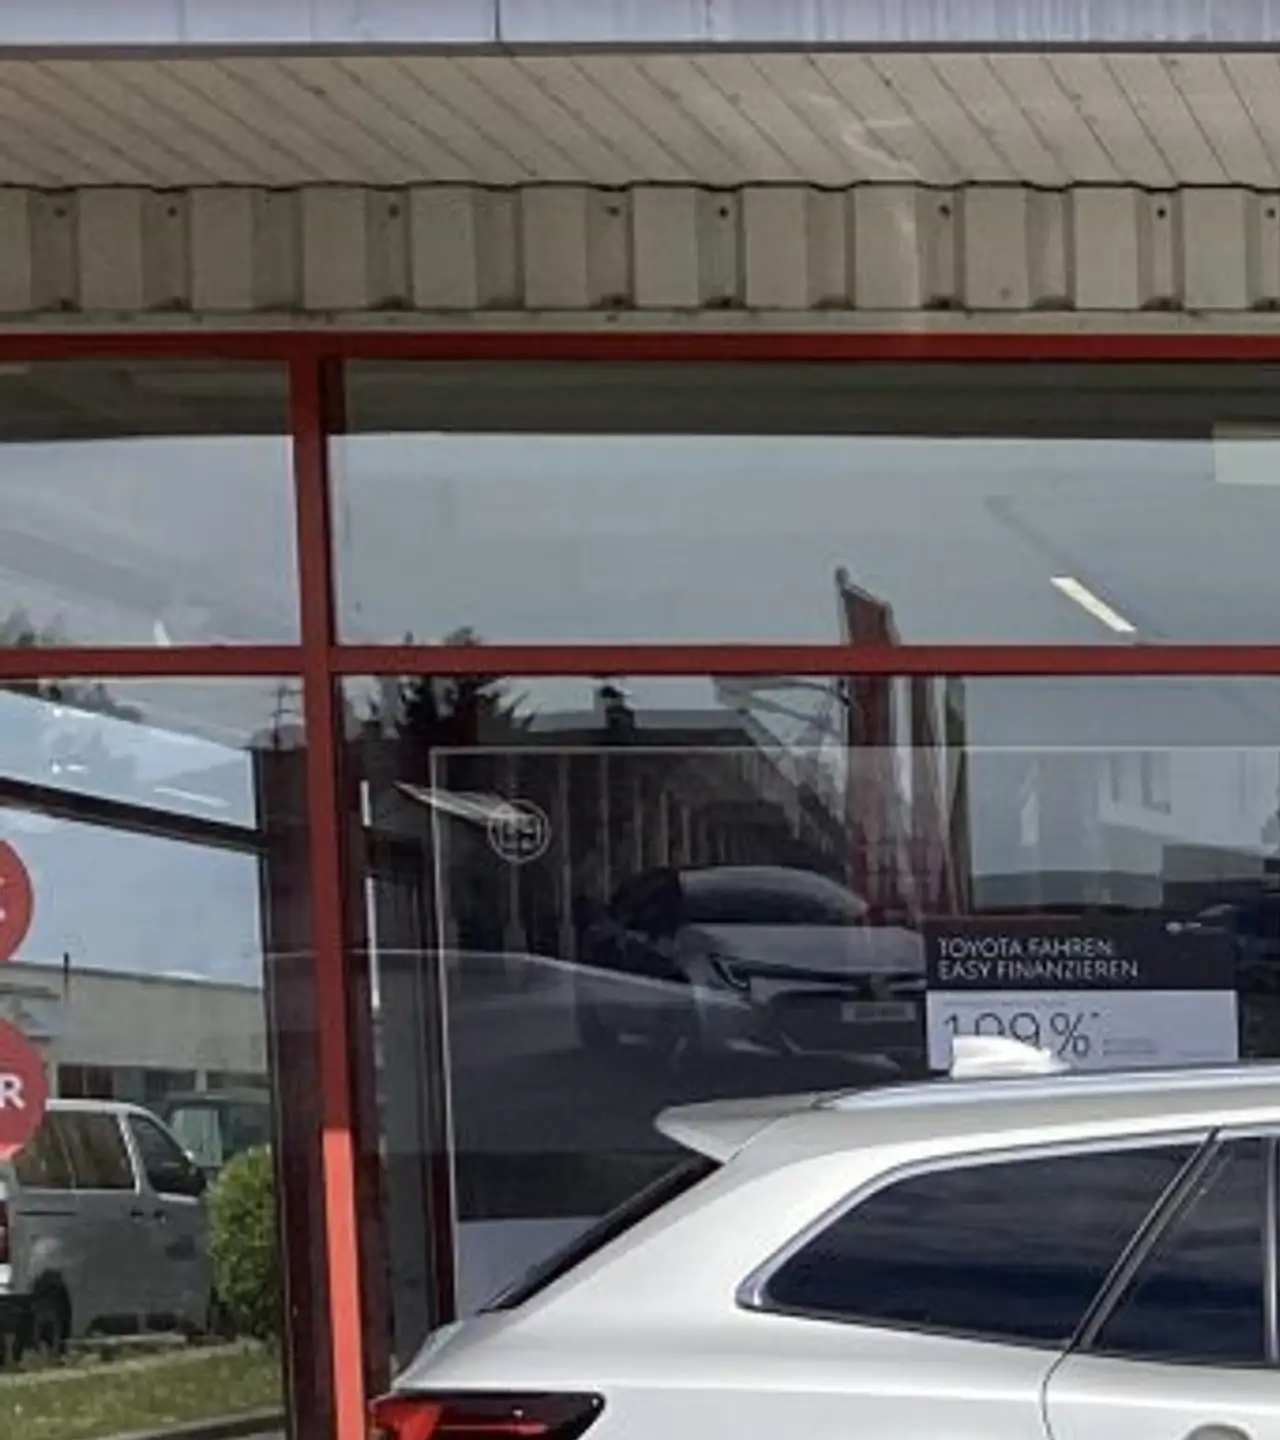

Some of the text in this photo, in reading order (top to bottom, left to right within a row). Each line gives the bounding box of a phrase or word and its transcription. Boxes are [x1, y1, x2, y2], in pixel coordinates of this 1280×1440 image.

[937, 936, 1113, 958] TOYOTA FAHREN
[937, 959, 1139, 981] EASY FINANZIEREN
